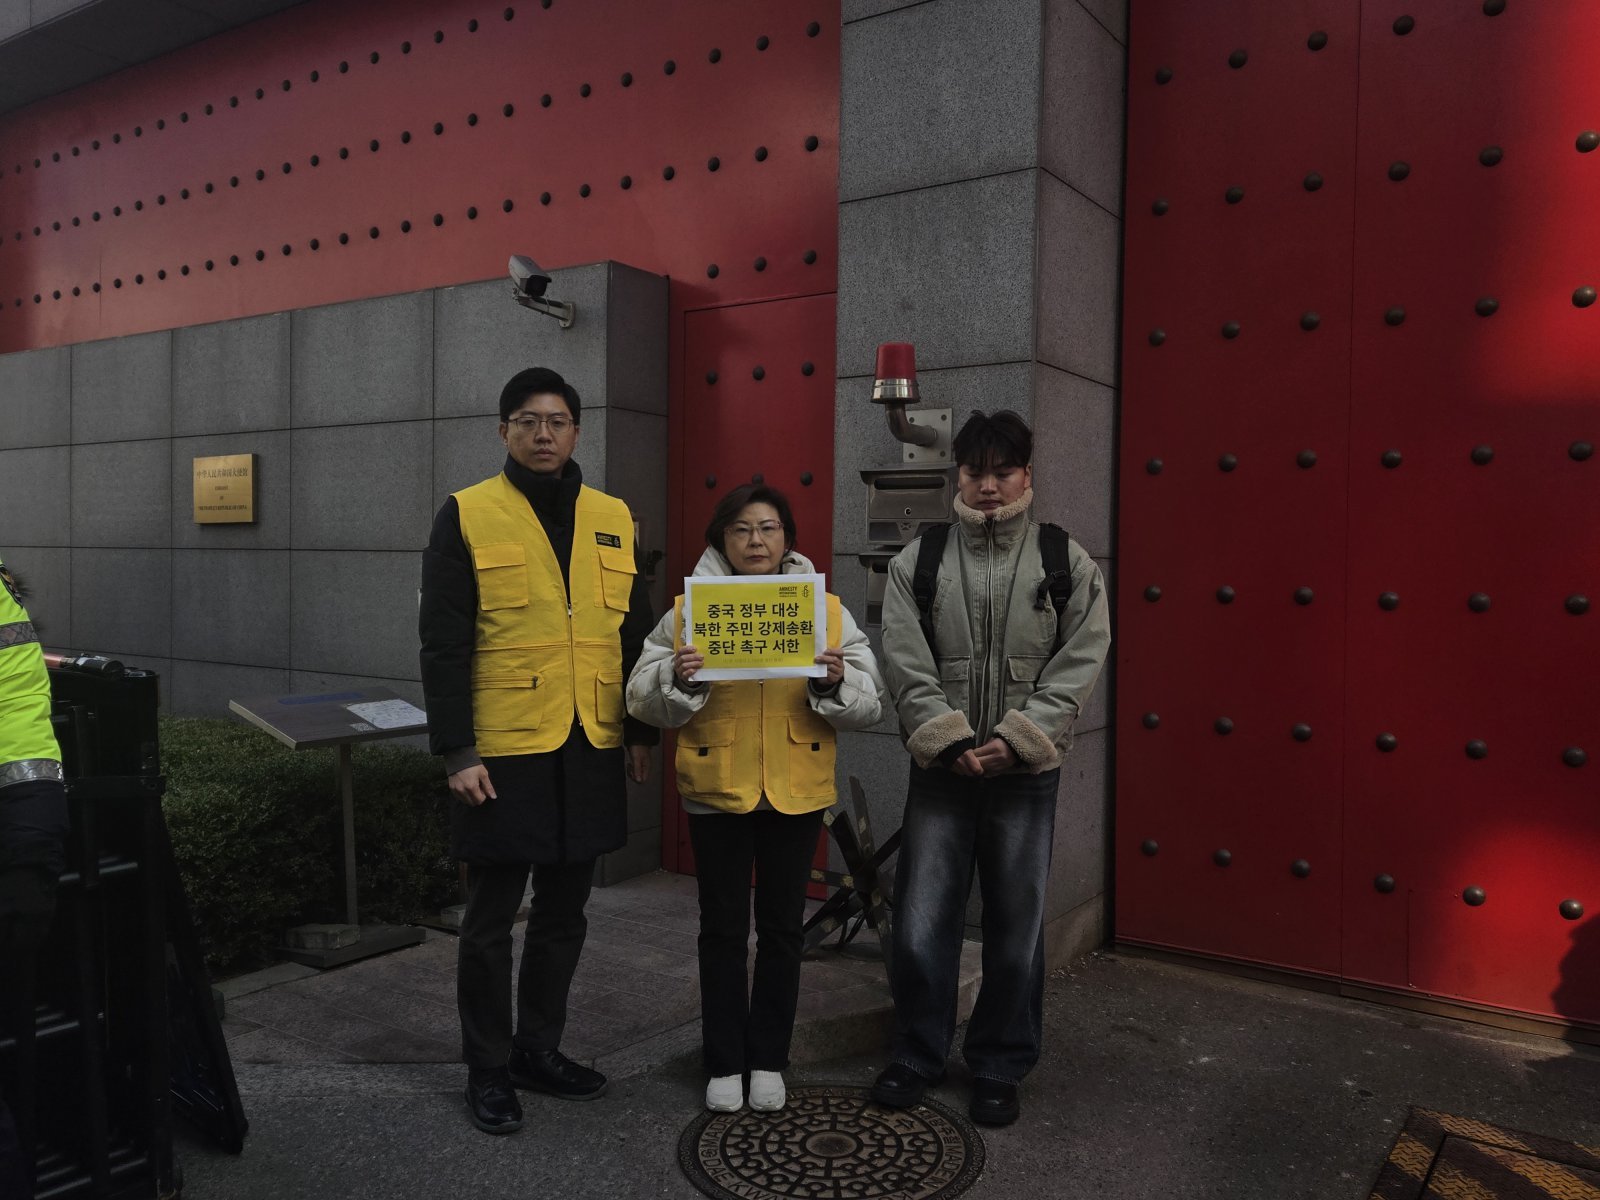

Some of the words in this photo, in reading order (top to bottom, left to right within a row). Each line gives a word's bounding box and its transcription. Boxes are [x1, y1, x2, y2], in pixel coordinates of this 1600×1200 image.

[707, 604, 735, 619] 중국
[740, 603, 767, 618] 정부
[772, 602, 799, 618] 대상
[694, 622, 722, 637] 북한
[726, 622, 753, 636] 주민
[758, 620, 813, 636] 강제송환
[708, 640, 735, 655] 중단
[740, 639, 767, 654] 촉구
[773, 638, 800, 653] 서한
